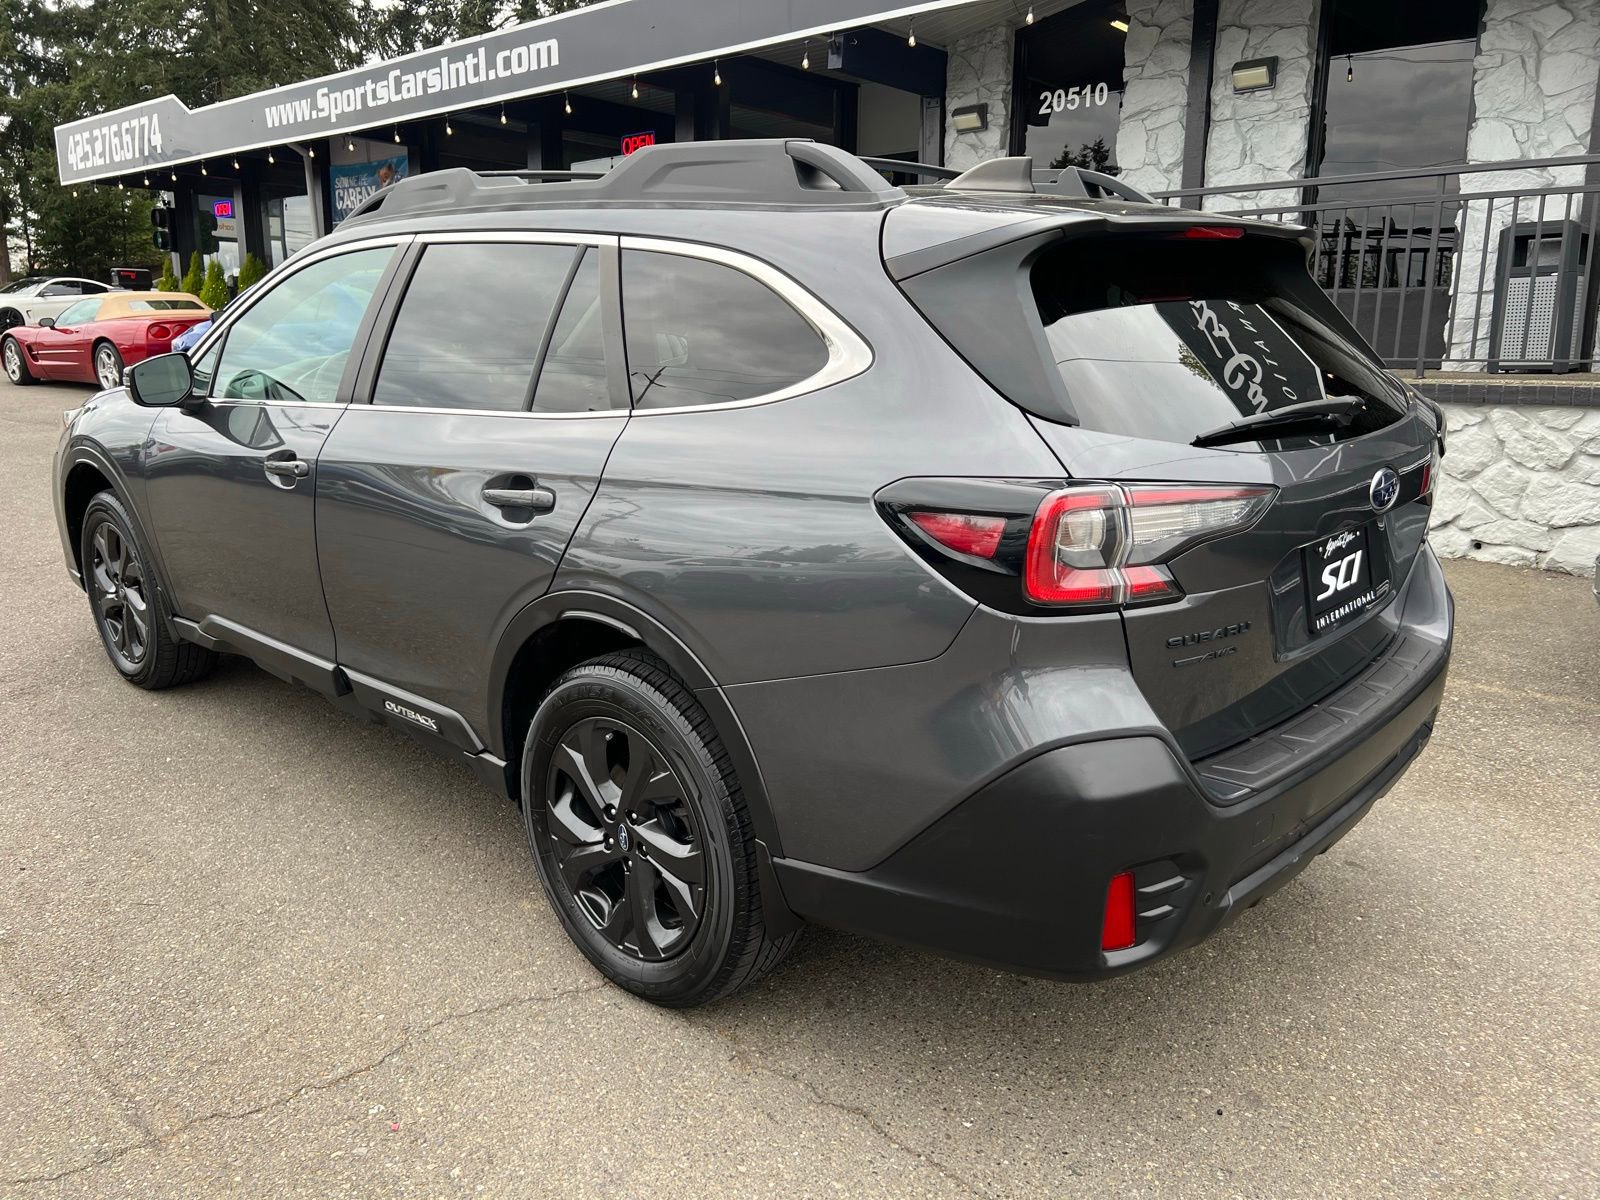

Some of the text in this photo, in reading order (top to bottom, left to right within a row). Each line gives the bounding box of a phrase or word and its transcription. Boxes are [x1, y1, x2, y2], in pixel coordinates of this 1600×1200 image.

[264, 37, 560, 123] www.SportsCarsIntl.com
[1038, 82, 1109, 115] 20510
[67, 113, 162, 171] 425.276.6774
[623, 134, 654, 156] OPEN
[1316, 590, 1376, 630] INTERNATIONAL
[1166, 621, 1252, 649] SUBARU
[384, 700, 438, 730] OUTBACK
